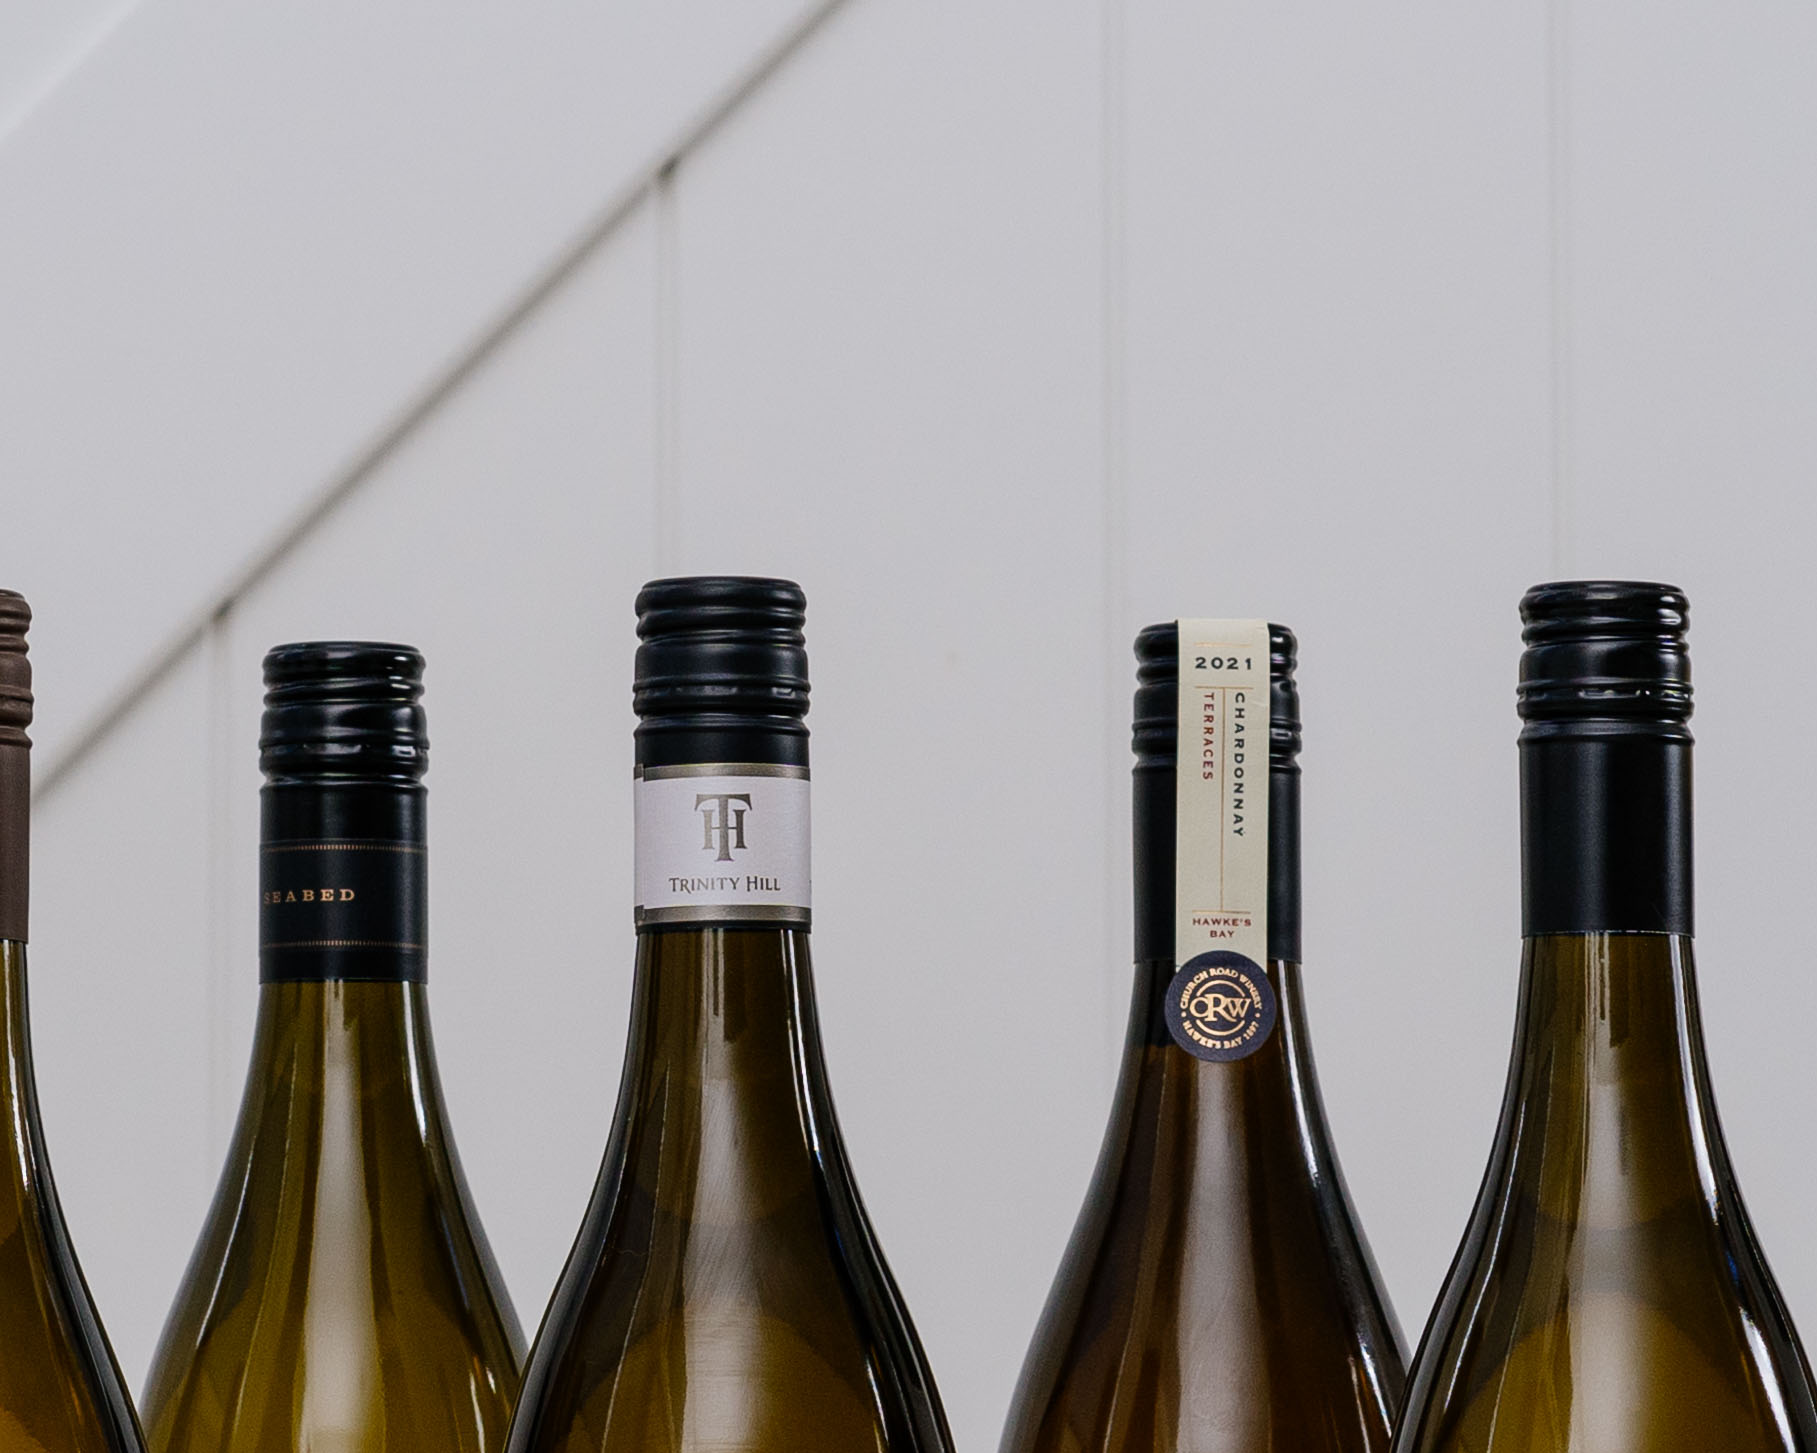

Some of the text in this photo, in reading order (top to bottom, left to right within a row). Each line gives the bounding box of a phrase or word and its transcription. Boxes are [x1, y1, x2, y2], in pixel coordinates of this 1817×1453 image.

[1195, 656, 1252, 671] 2021
[1202, 692, 1215, 781] TERRACES
[1233, 692, 1245, 837] CHARDONNAY
[668, 876, 781, 894] TRINITY HILL
[264, 888, 355, 905] SEABED
[1192, 917, 1252, 927] HAWKE'S
[1209, 929, 1235, 938] BAY
[1209, 967, 1239, 978] ROAD
[1223, 1037, 1242, 1049] BAY
